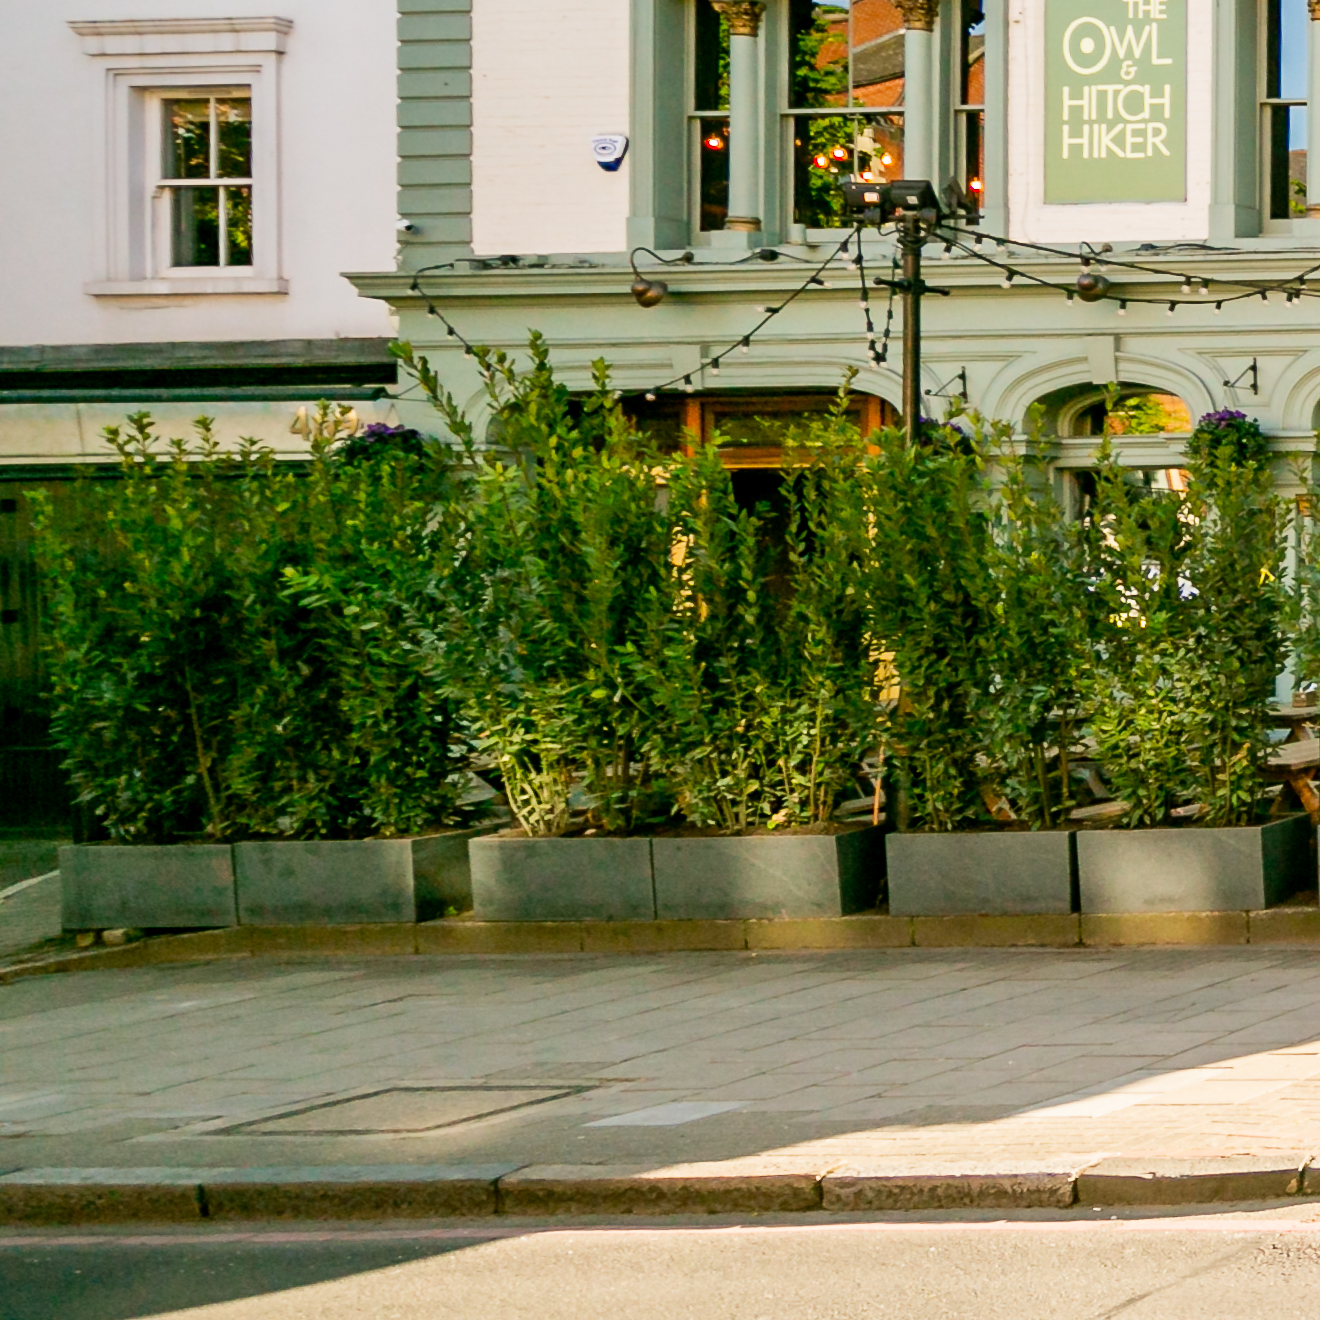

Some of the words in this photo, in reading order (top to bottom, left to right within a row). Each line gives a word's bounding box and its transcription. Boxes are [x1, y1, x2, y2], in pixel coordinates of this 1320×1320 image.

[1062, 16, 1173, 75] OWL
[1120, 60, 1138, 81] &
[1062, 84, 1171, 121] HITCH
[1061, 122, 1171, 160] HIKER
